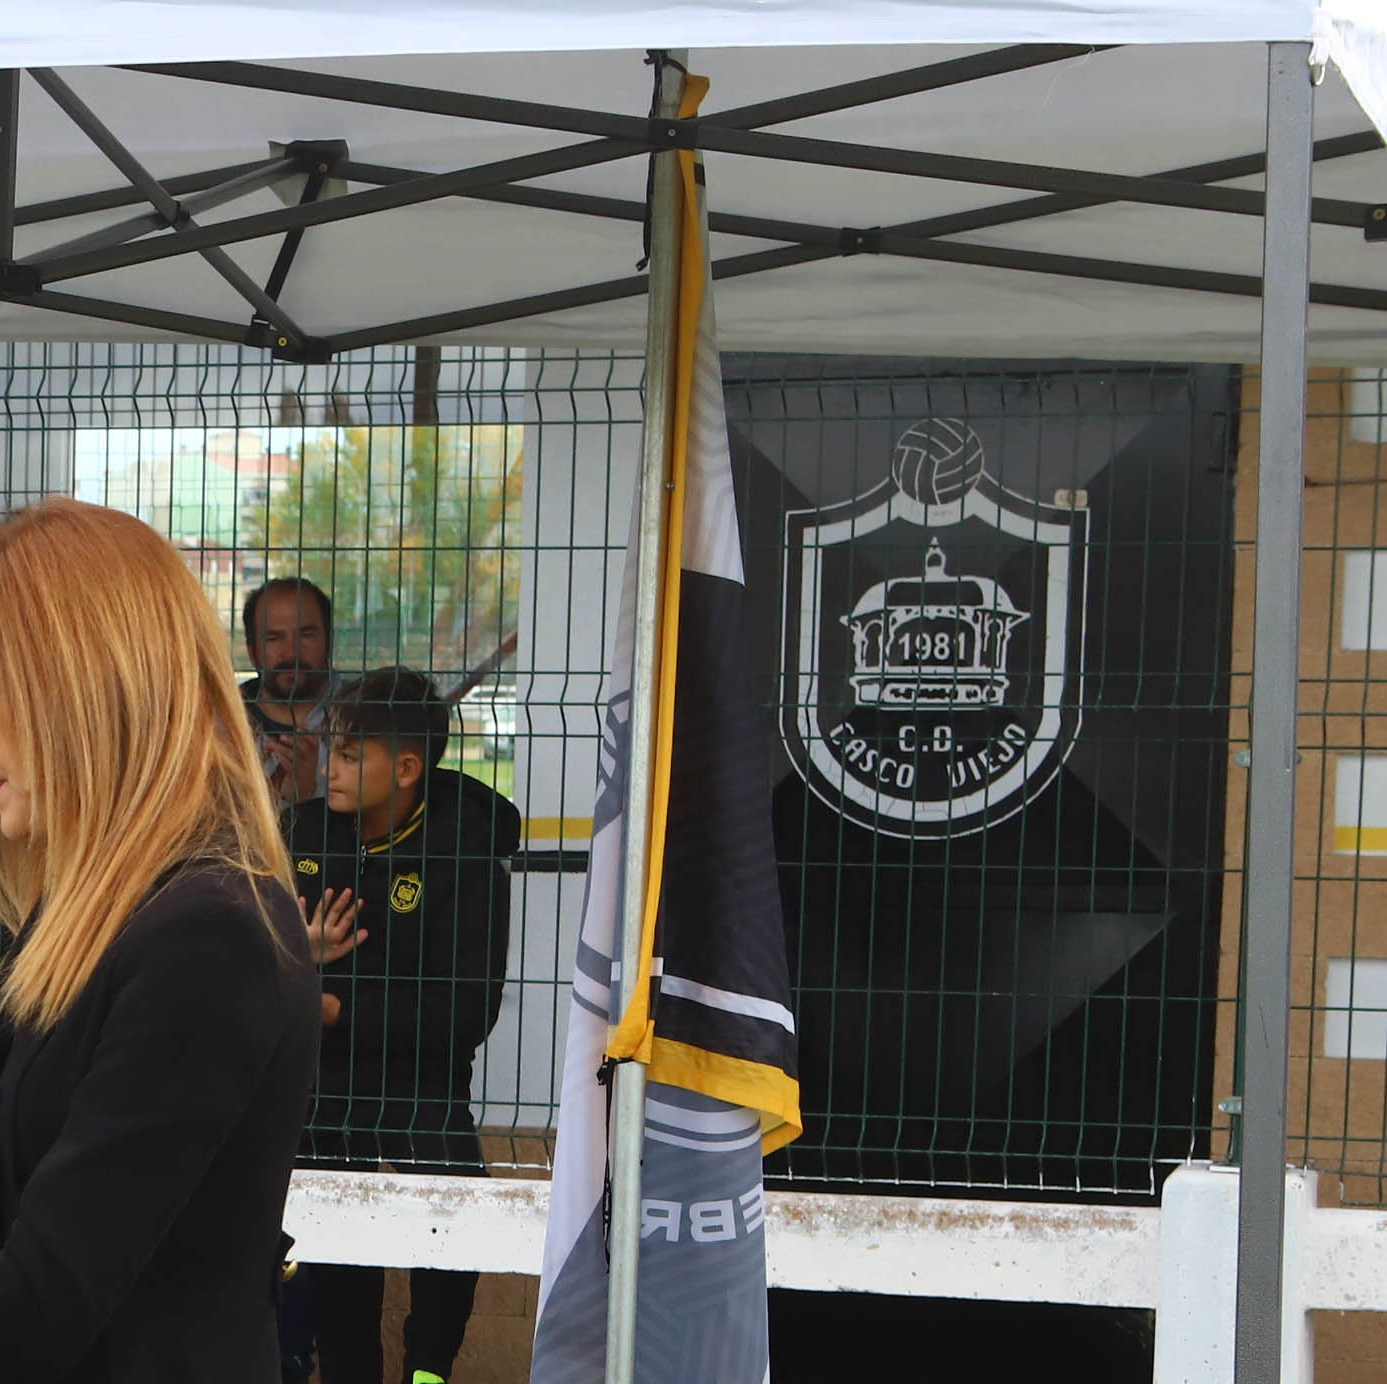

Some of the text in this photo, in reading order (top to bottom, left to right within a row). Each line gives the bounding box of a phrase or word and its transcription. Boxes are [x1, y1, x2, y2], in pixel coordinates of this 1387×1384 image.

[898, 632, 966, 661] 1981
[898, 725, 964, 753] C.D.
[829, 722, 1027, 788] CASCO VIEJO
